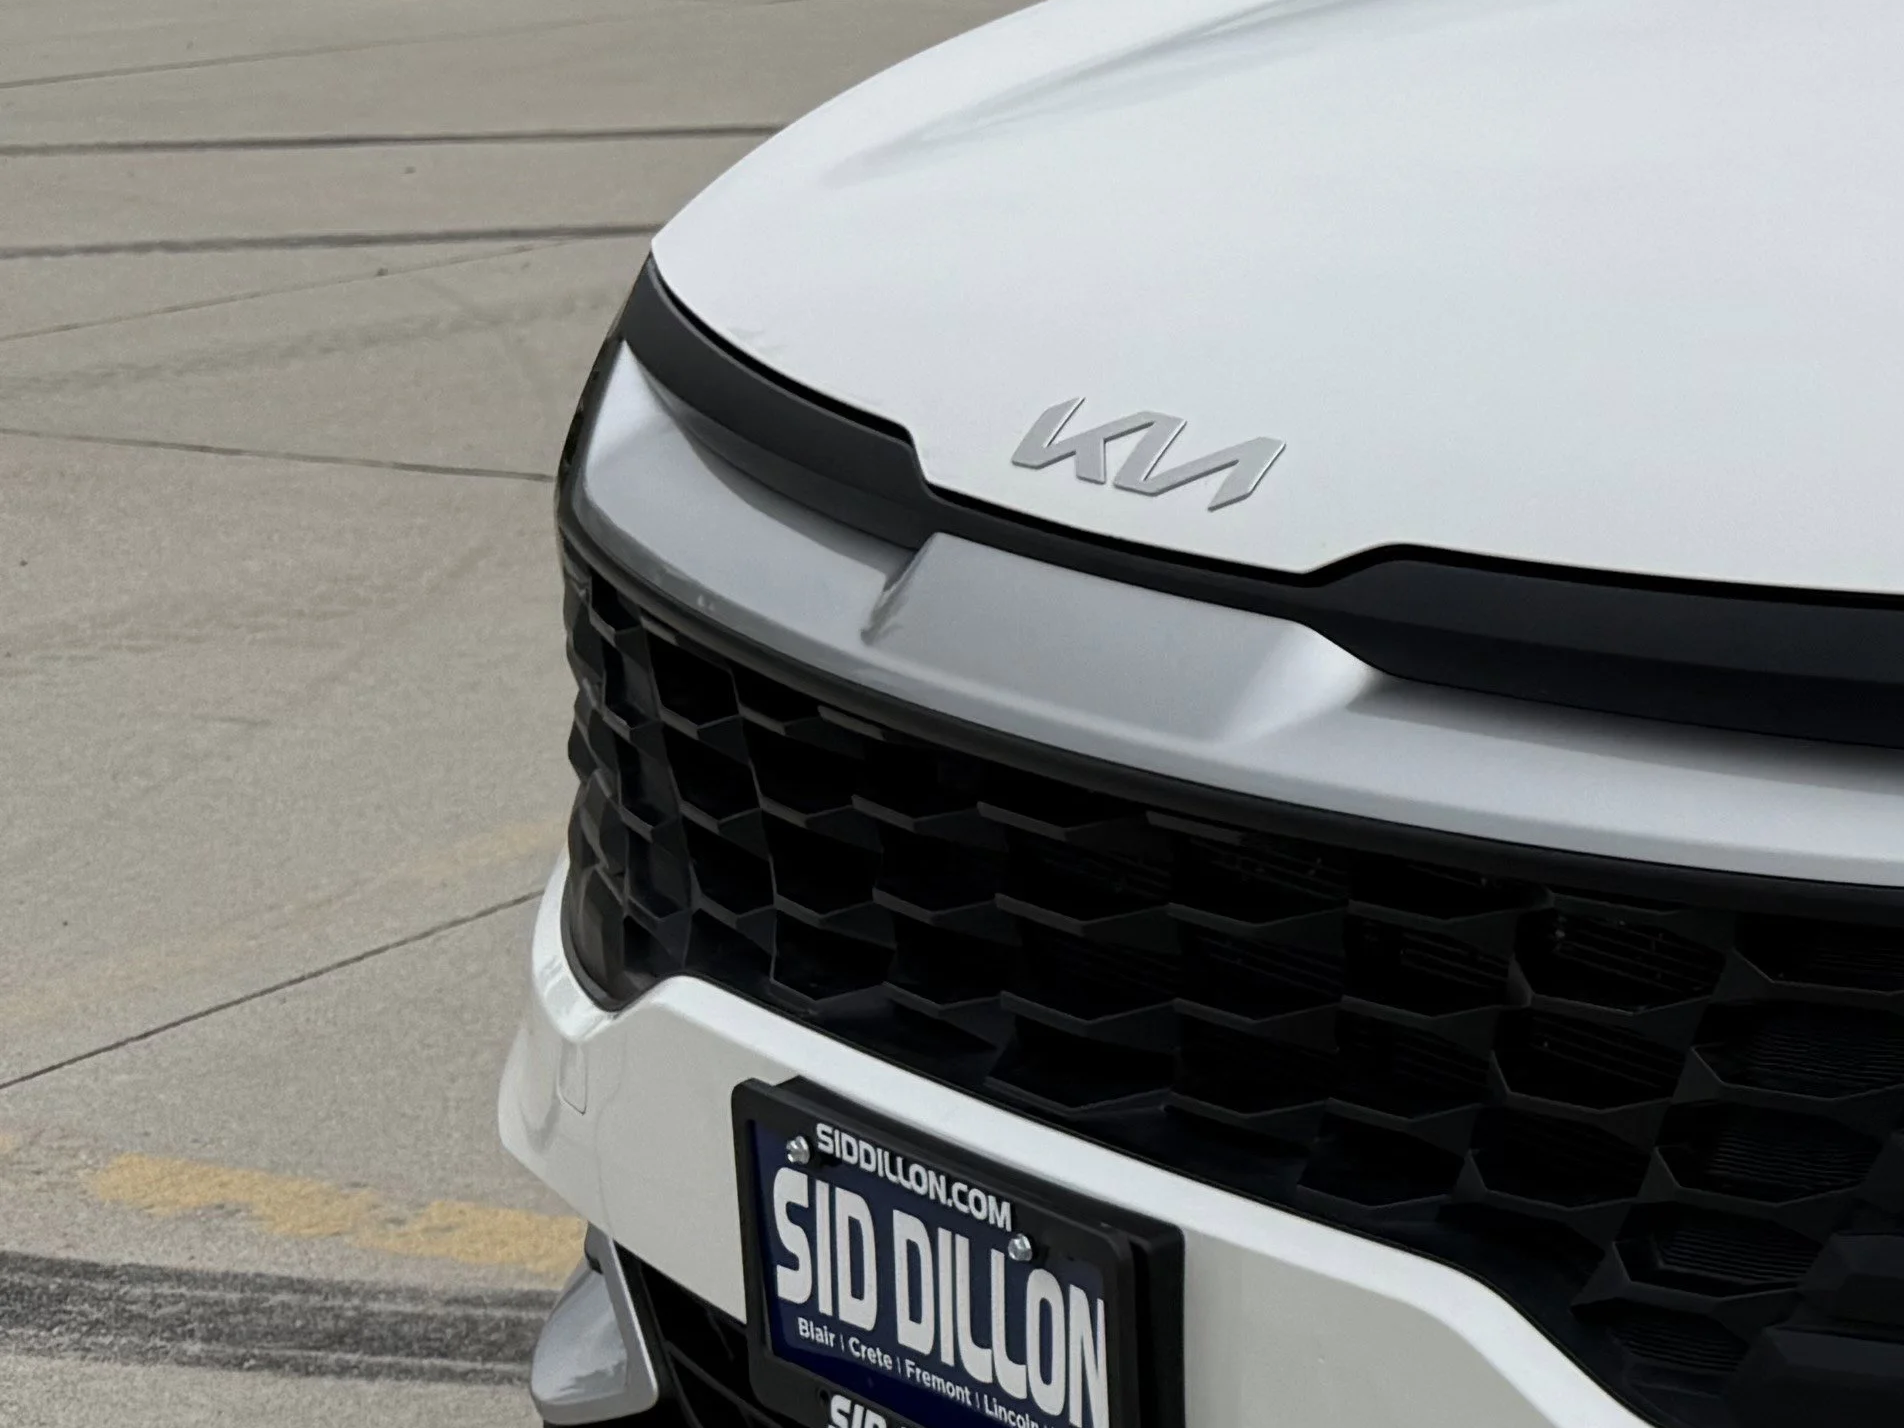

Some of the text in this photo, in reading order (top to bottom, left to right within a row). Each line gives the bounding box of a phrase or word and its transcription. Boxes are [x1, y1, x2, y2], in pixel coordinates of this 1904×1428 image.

[815, 1122, 1012, 1232] SIDDILLON.COM
[772, 1166, 878, 1332] SID
[797, 1316, 836, 1349] Blair
[847, 1336, 893, 1371] Crete
[904, 1358, 972, 1407] Fremont
